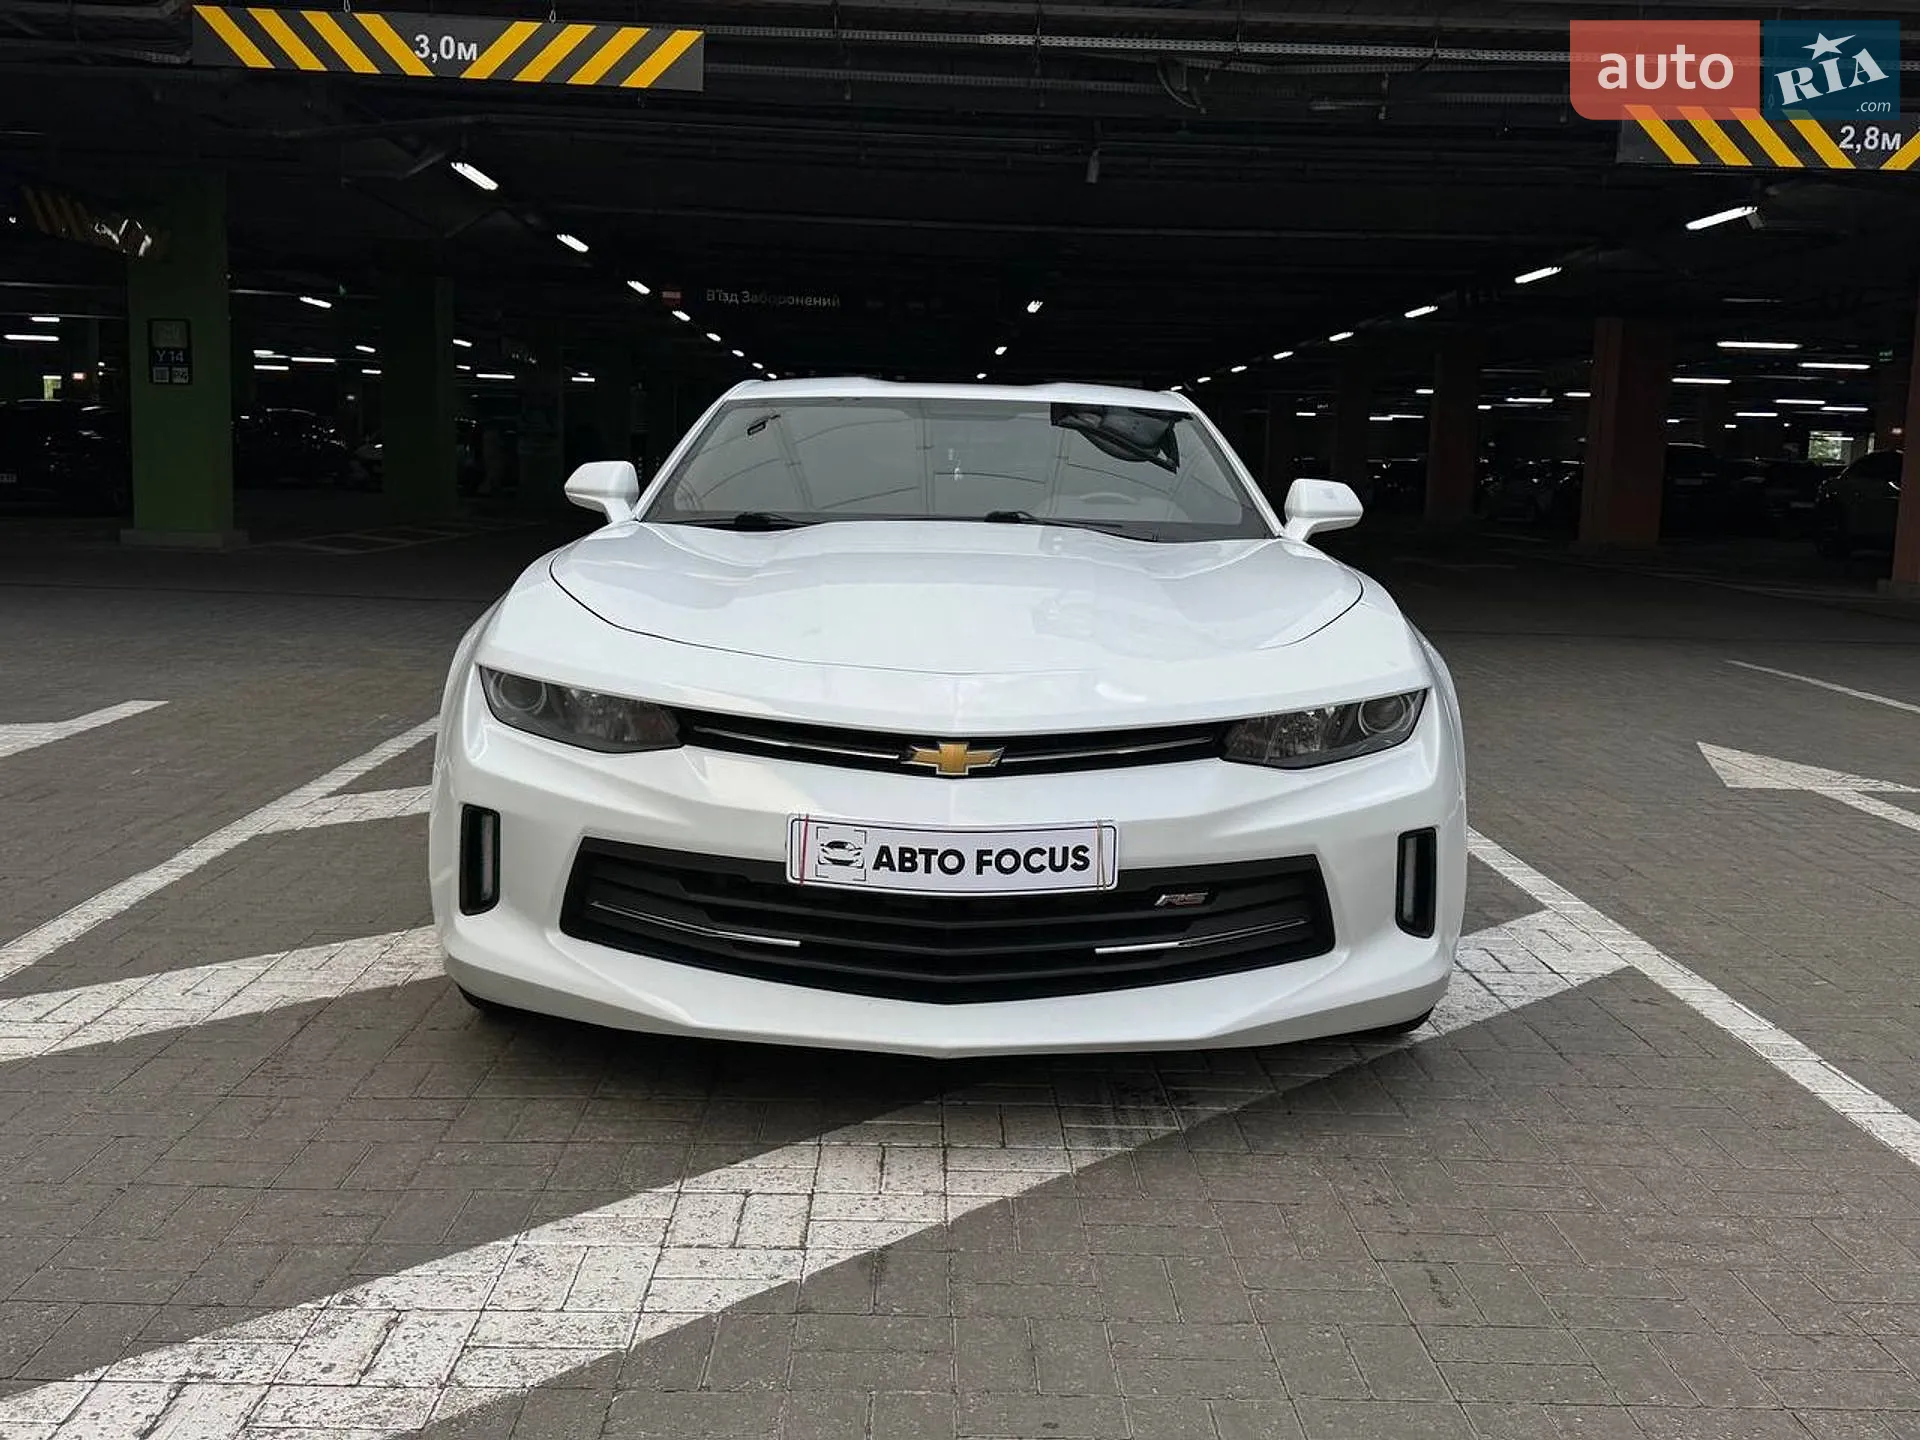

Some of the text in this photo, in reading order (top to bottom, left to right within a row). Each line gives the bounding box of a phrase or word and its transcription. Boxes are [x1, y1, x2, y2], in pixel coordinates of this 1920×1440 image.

[414, 33, 478, 64] 3,0м
[1838, 125, 1902, 154] 2,8м
[740, 289, 841, 308] Заборонений
[975, 844, 1091, 876] FOCUS
